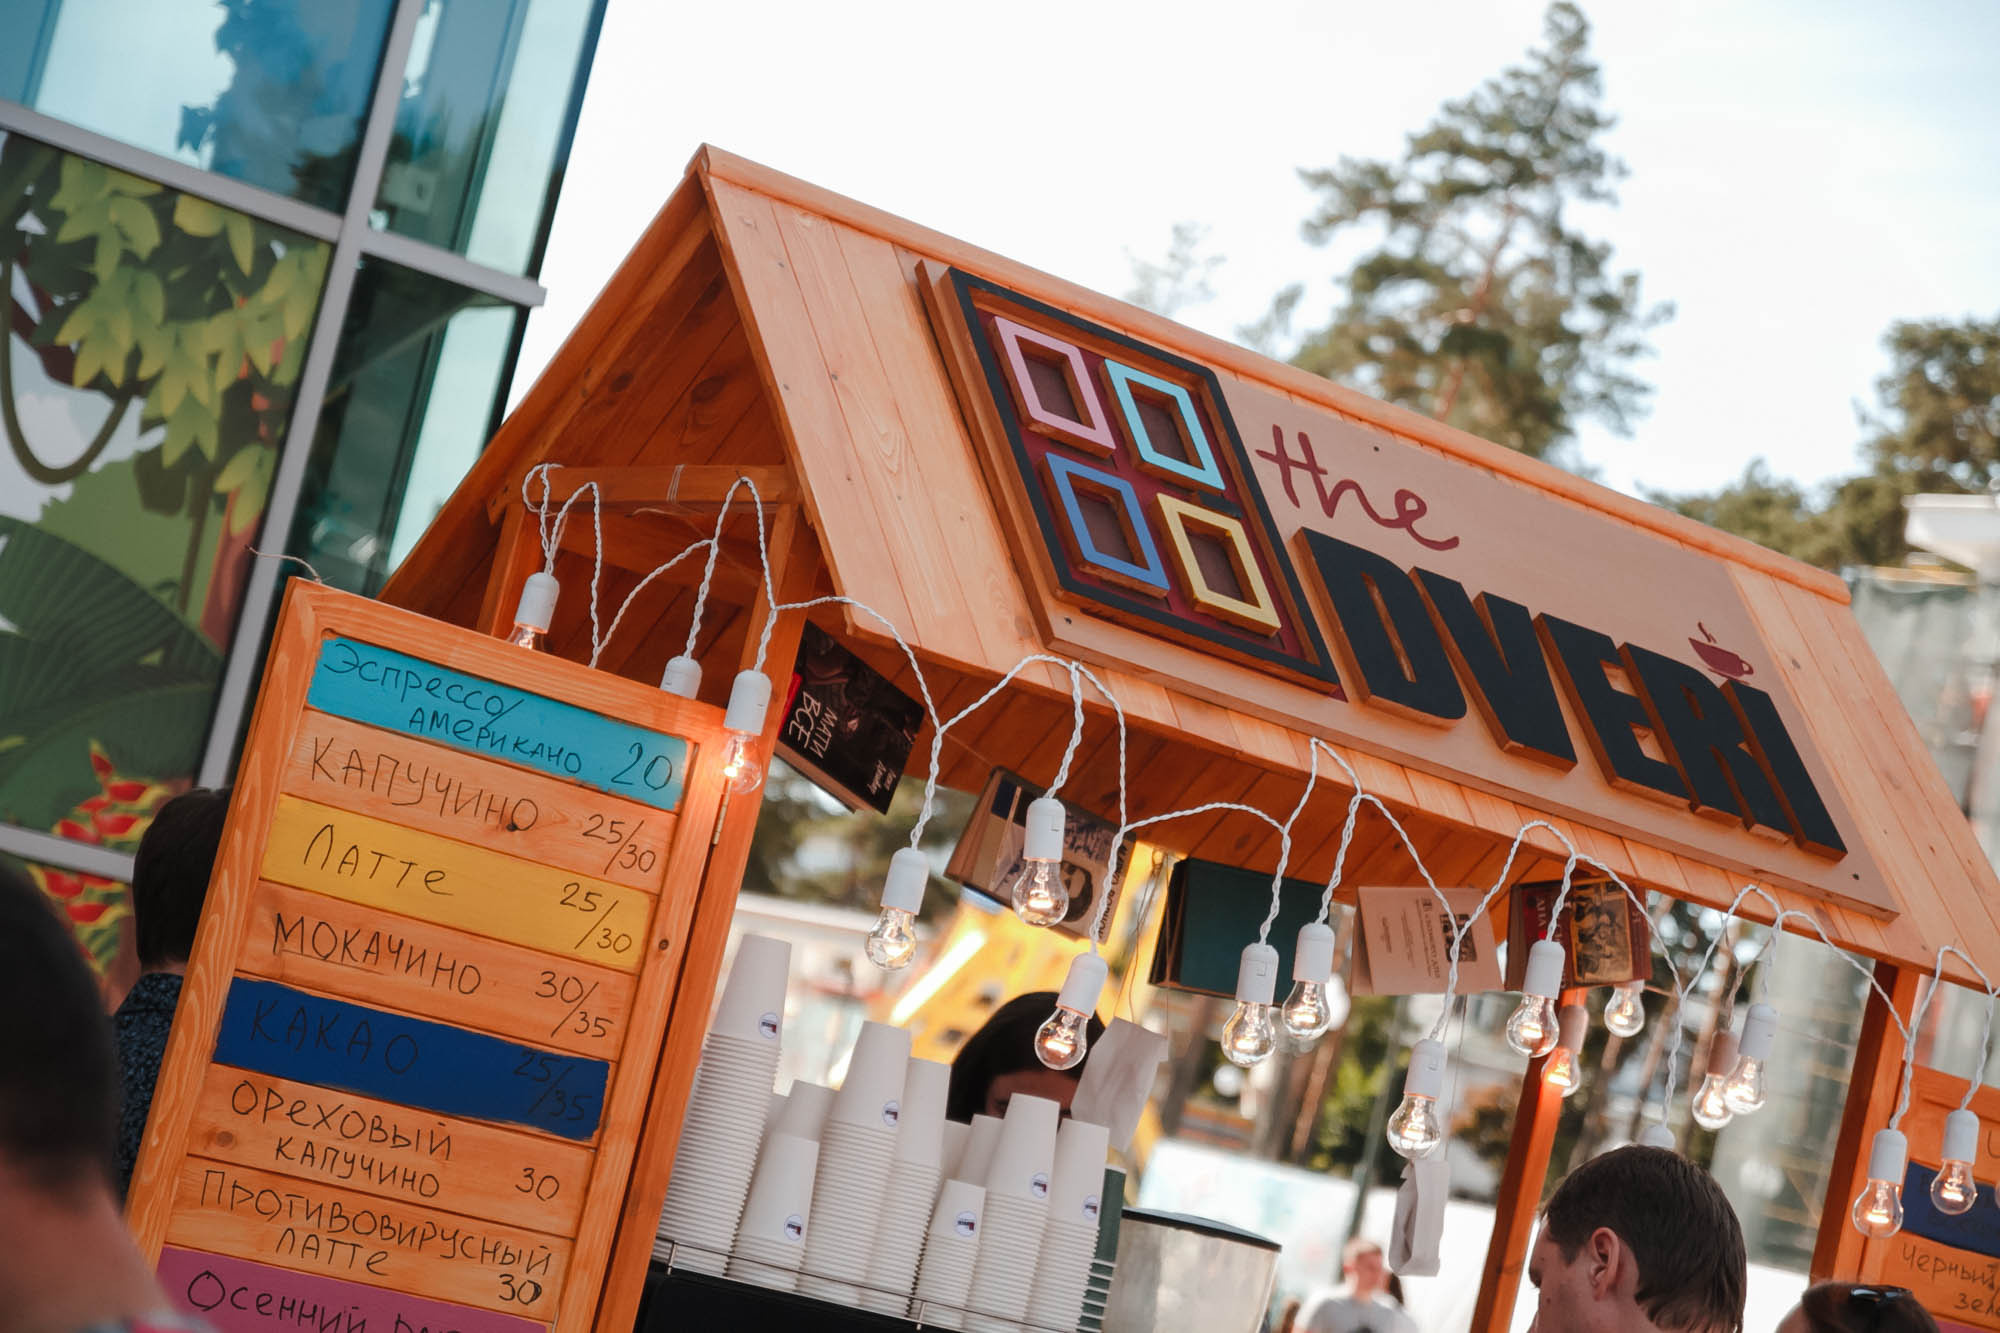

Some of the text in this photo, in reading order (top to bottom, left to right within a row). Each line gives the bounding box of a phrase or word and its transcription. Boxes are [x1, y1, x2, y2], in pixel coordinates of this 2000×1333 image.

[1255, 424, 1460, 551] the
[1291, 526, 1848, 861] DVERI
[311, 736, 539, 832] КАПУЧИНО
[610, 742, 673, 791] 20
[273, 912, 482, 996] МОКАЧИНО
[250, 999, 419, 1075] КАКАО
[275, 1136, 560, 1202] КАПУЧИНО 30
[498, 1273, 542, 1305] 30
